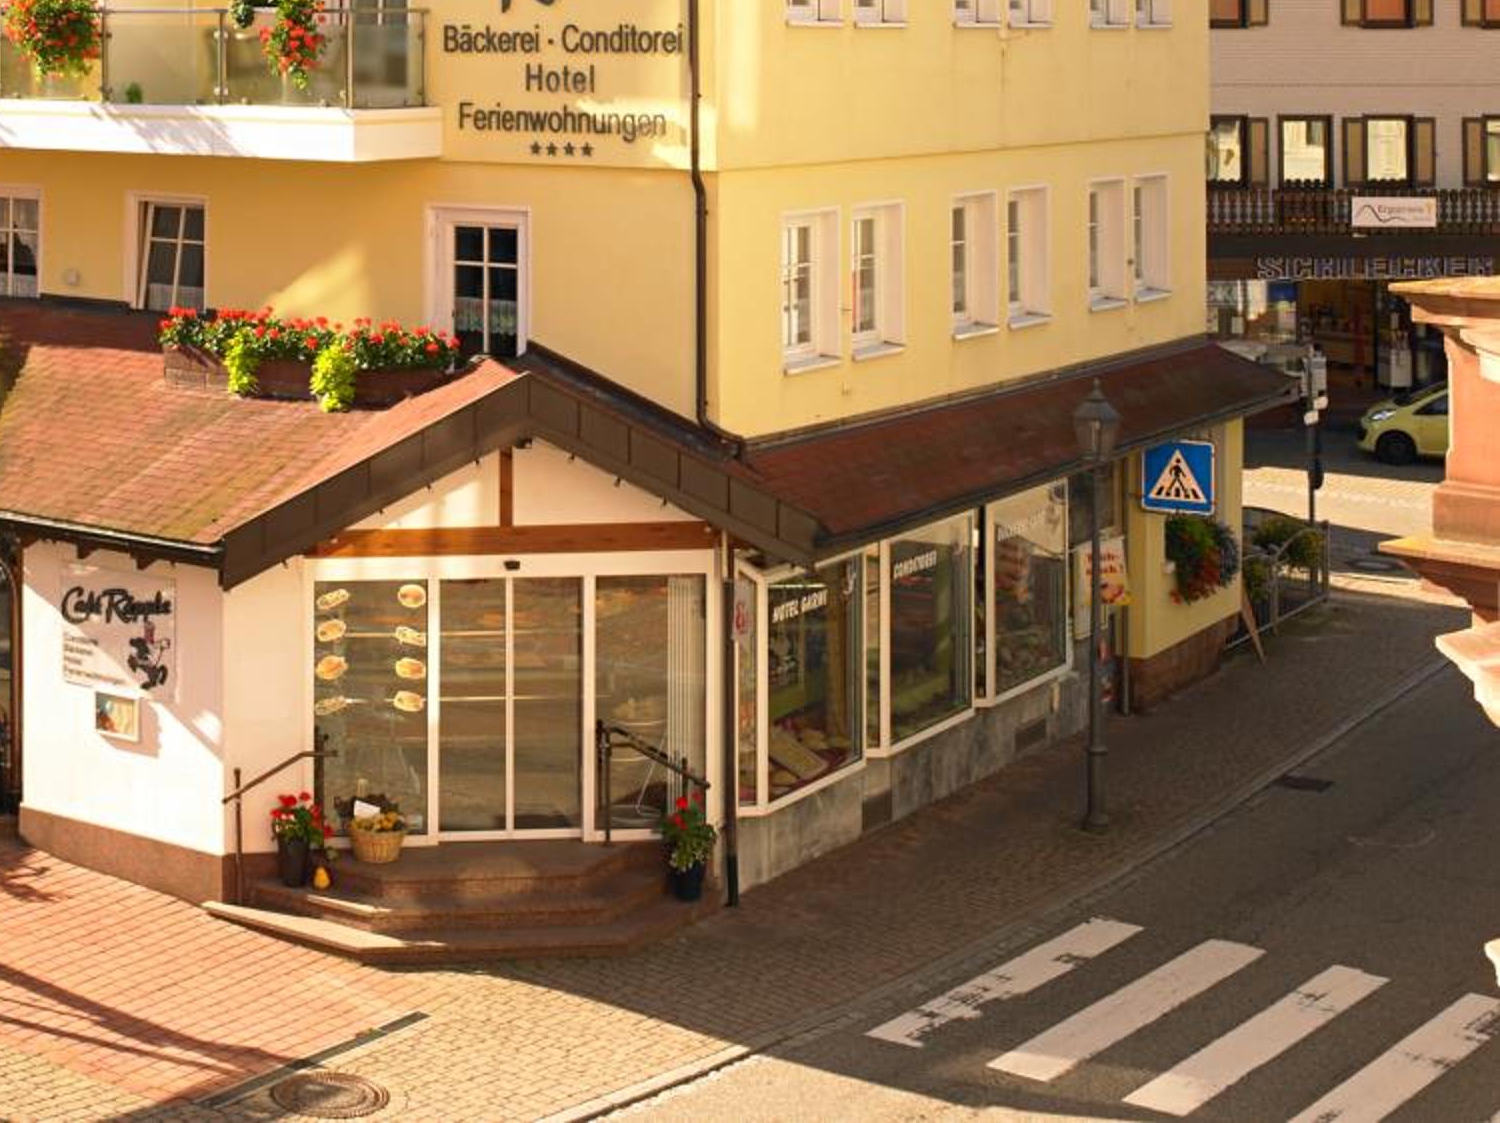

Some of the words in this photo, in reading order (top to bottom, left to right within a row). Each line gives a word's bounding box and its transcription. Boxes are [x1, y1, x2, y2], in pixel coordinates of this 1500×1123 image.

[443, 24, 540, 53] Bäckerei
[561, 23, 683, 54] Conditorei
[525, 64, 595, 94] Hotel
[458, 102, 666, 142] Ferienwohnungen
